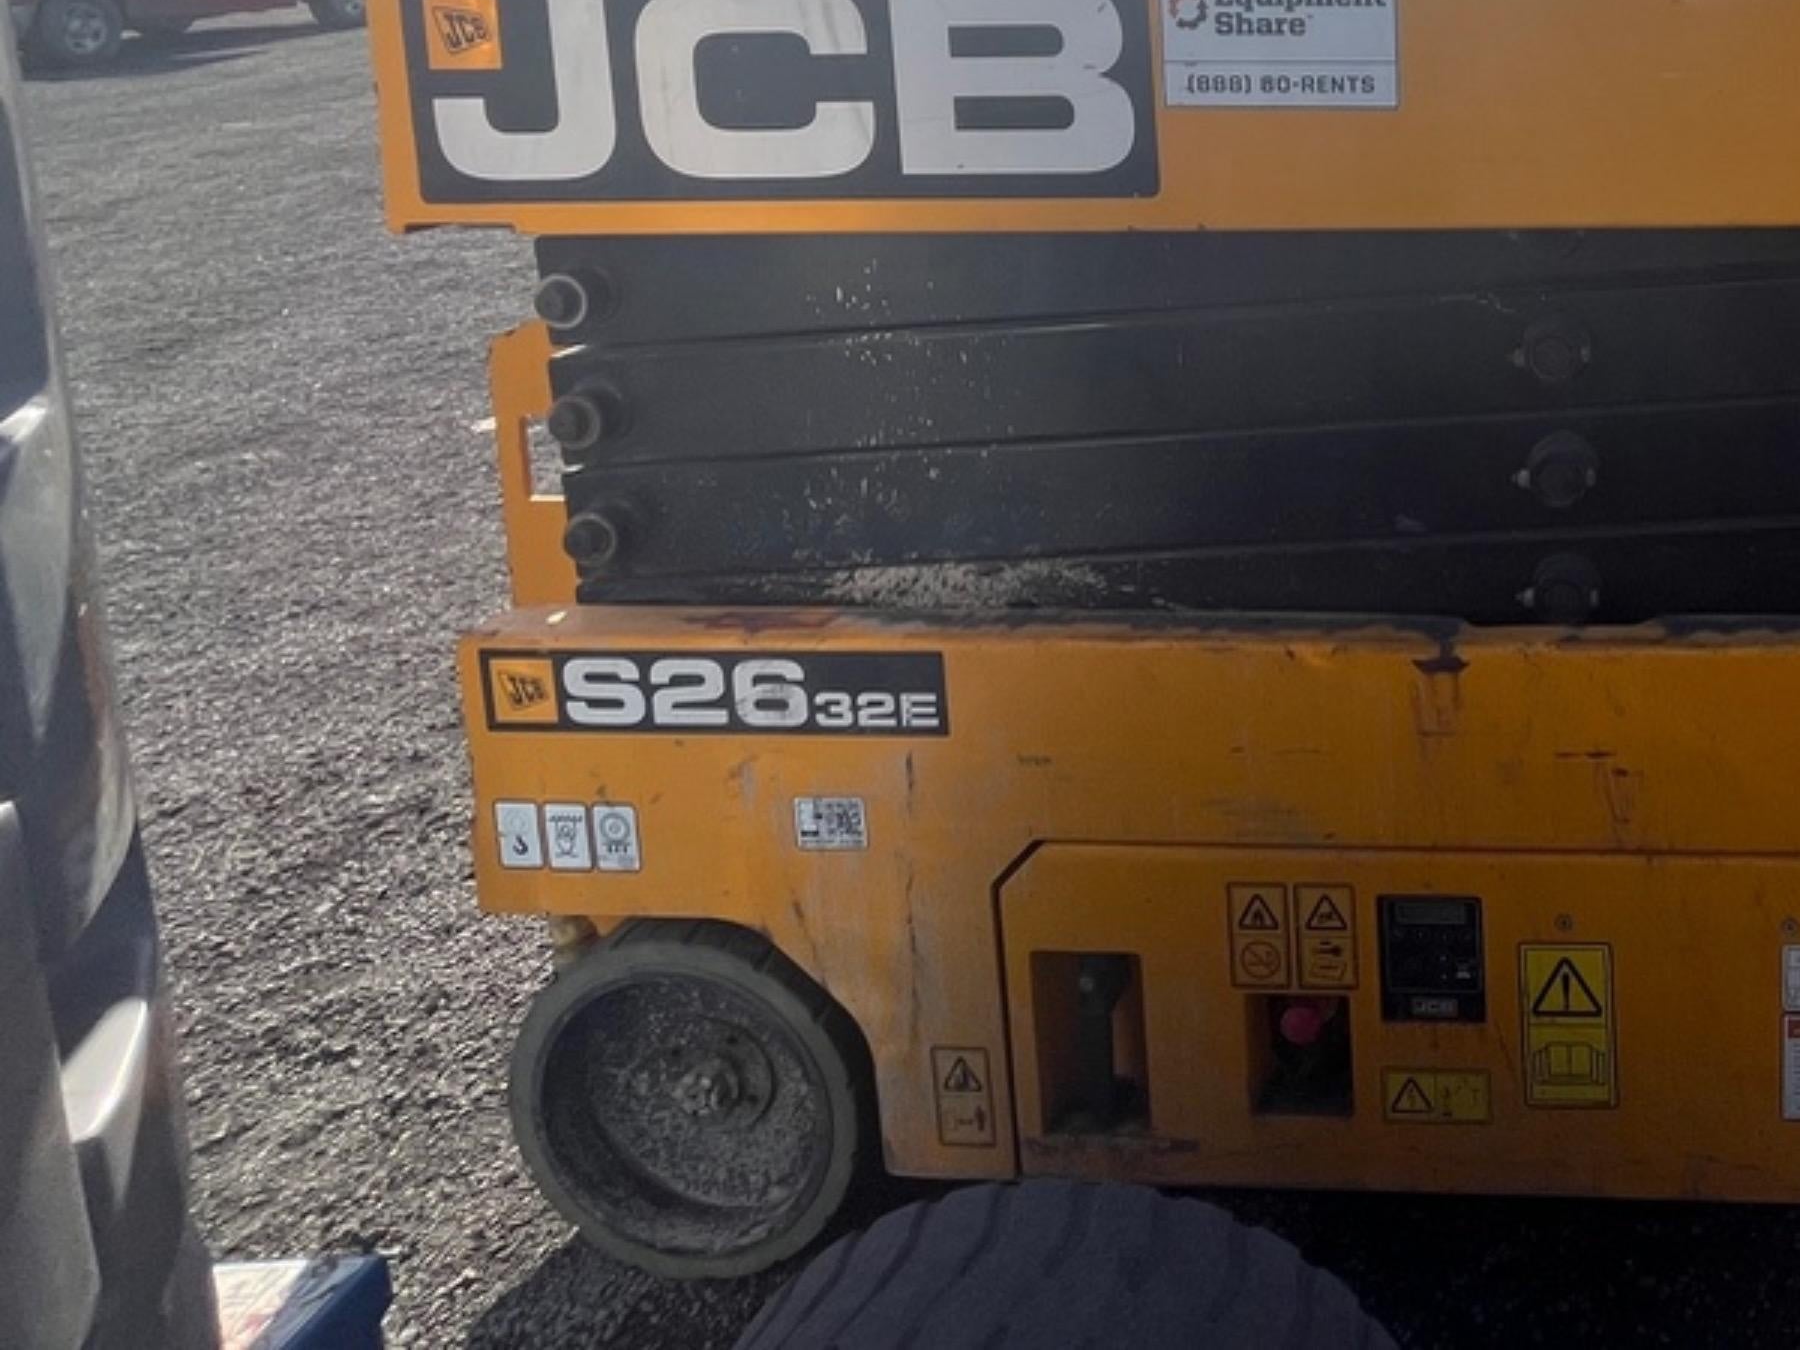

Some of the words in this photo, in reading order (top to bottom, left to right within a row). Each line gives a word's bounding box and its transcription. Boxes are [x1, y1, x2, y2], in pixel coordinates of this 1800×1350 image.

[439, 12, 489, 49] JCB
[1214, 11, 1307, 37] Share
[1186, 73, 1252, 95] (888)
